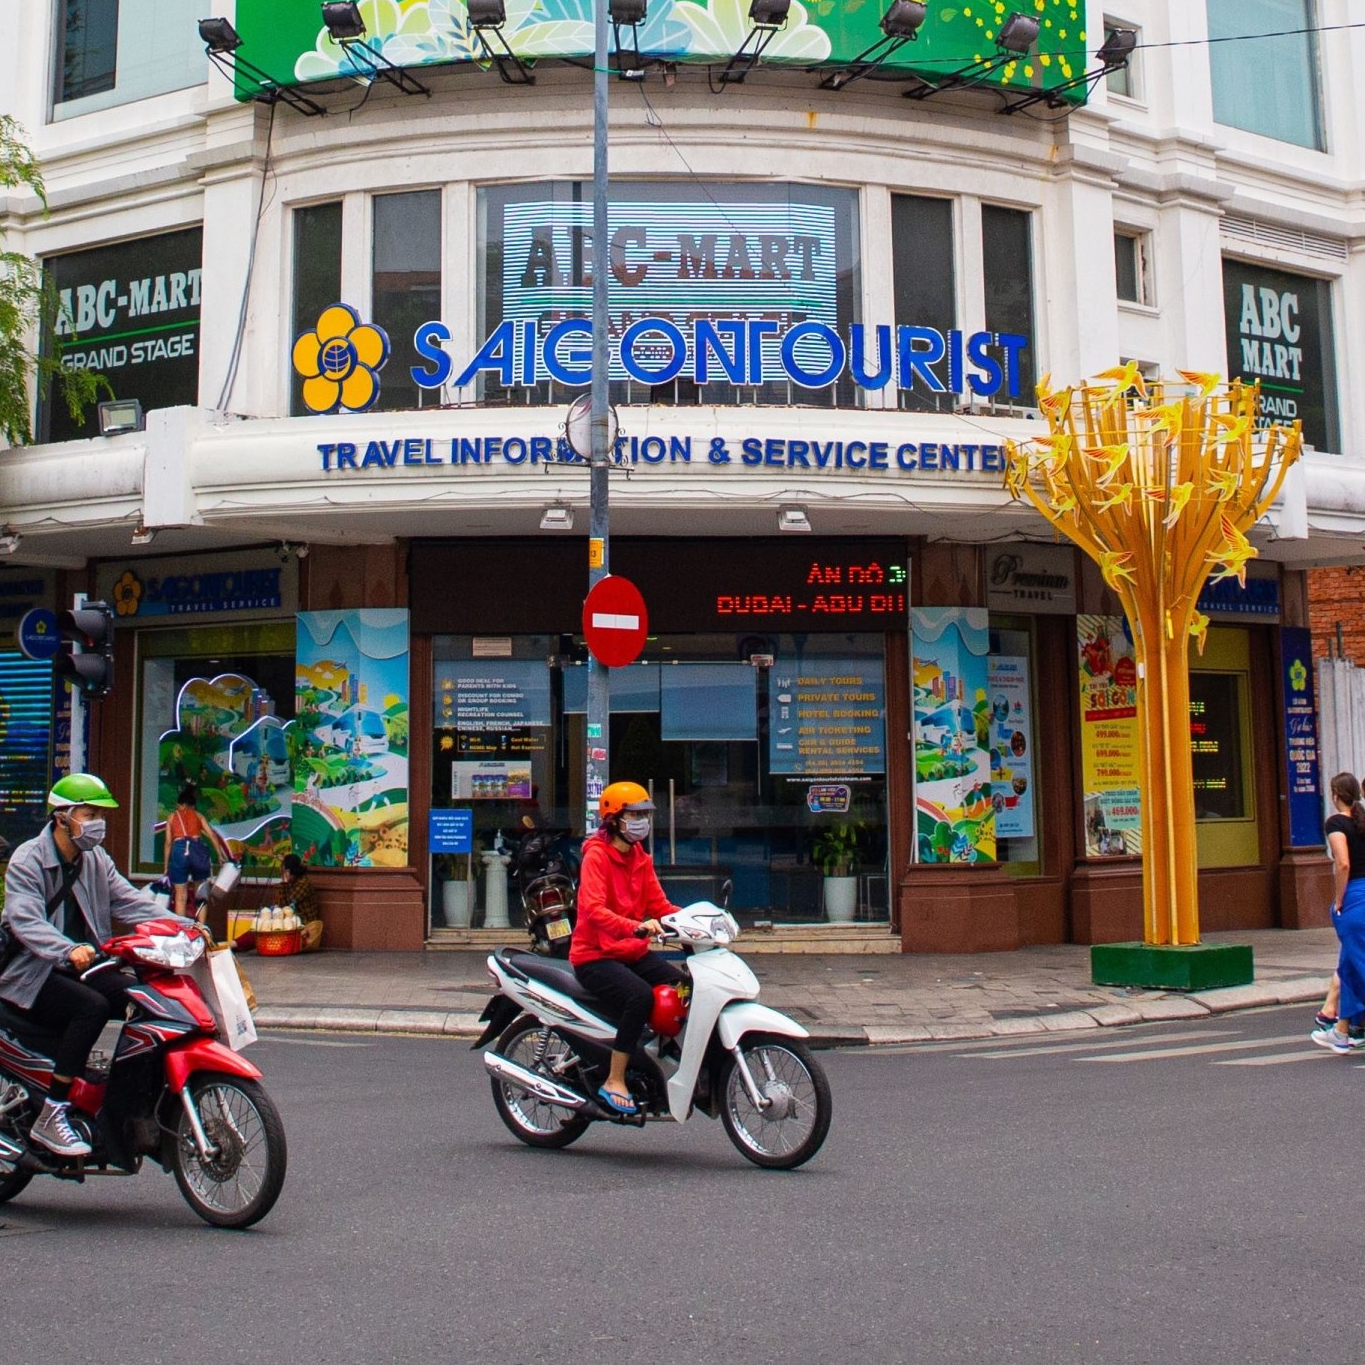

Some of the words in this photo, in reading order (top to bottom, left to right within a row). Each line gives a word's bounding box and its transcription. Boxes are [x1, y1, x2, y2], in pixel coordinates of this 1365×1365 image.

[54, 268, 203, 336] ABC-MART
[1239, 283, 1301, 344] ABC
[61, 345, 127, 373] GRAND
[131, 333, 195, 364] STAGE
[410, 317, 1029, 398] SAIGONTOURIST
[1240, 338, 1303, 381] MART
[316, 438, 443, 471] TRAVEL
[451, 434, 692, 467] INFORMTION
[708, 435, 732, 465] &
[741, 437, 889, 470] SERVICE
[171, 602, 214, 613] TRAVEL
[223, 597, 276, 610] SERVICE
[797, 677, 827, 685] DAILY
[830, 677, 863, 685] TOURS
[798, 693, 840, 702] PRIVATE
[843, 693, 876, 702] TOURS
[798, 710, 830, 719] HOTEL
[833, 709, 879, 718] BOOKING
[798, 727, 816, 735] AIR
[819, 725, 872, 734] TICKETING
[828, 738, 856, 746] GUIDE
[798, 747, 834, 755] RENTAL
[837, 746, 881, 754] SERVICES
